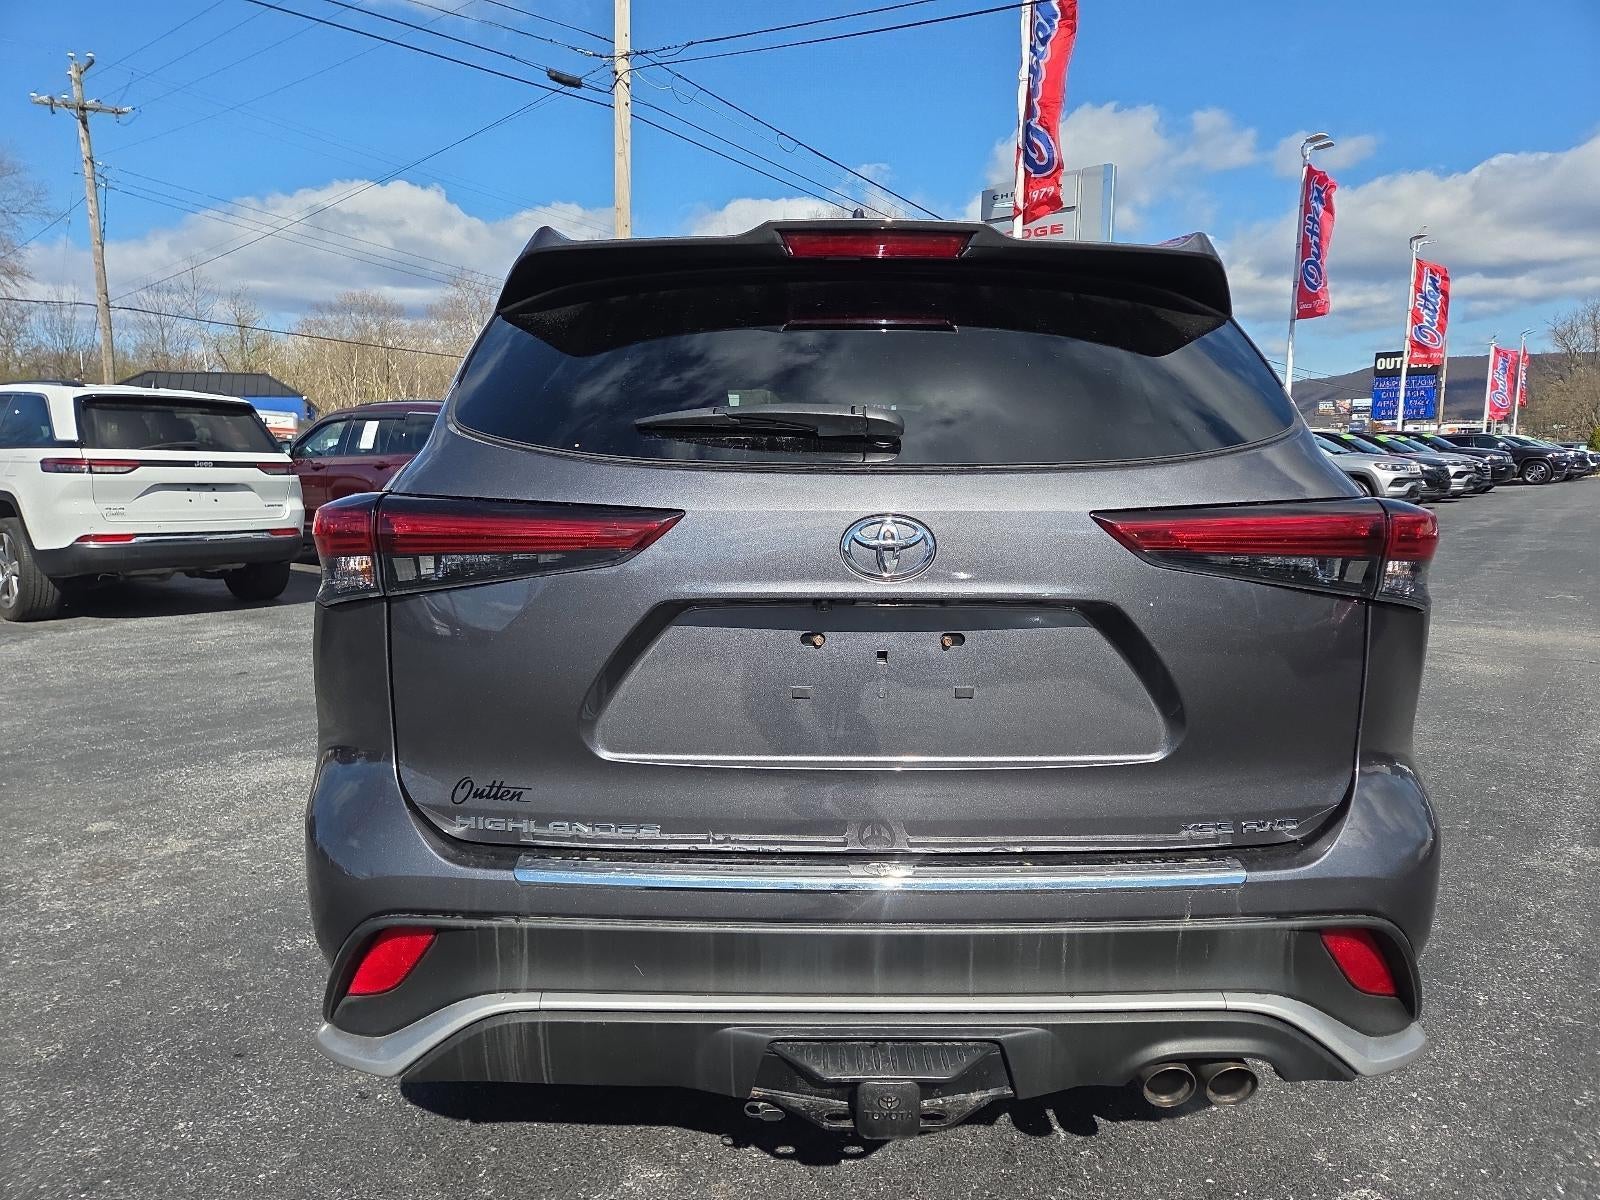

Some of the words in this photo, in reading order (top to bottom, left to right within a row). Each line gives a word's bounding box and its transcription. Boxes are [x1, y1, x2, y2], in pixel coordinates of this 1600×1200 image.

[1302, 174, 1328, 293] Outten
[1413, 267, 1443, 349] Outten
[194, 460, 214, 468] Jeep
[450, 776, 533, 805] Outten
[455, 815, 662, 838] HIGHLANDER
[863, 1110, 913, 1121] TOYOTA
